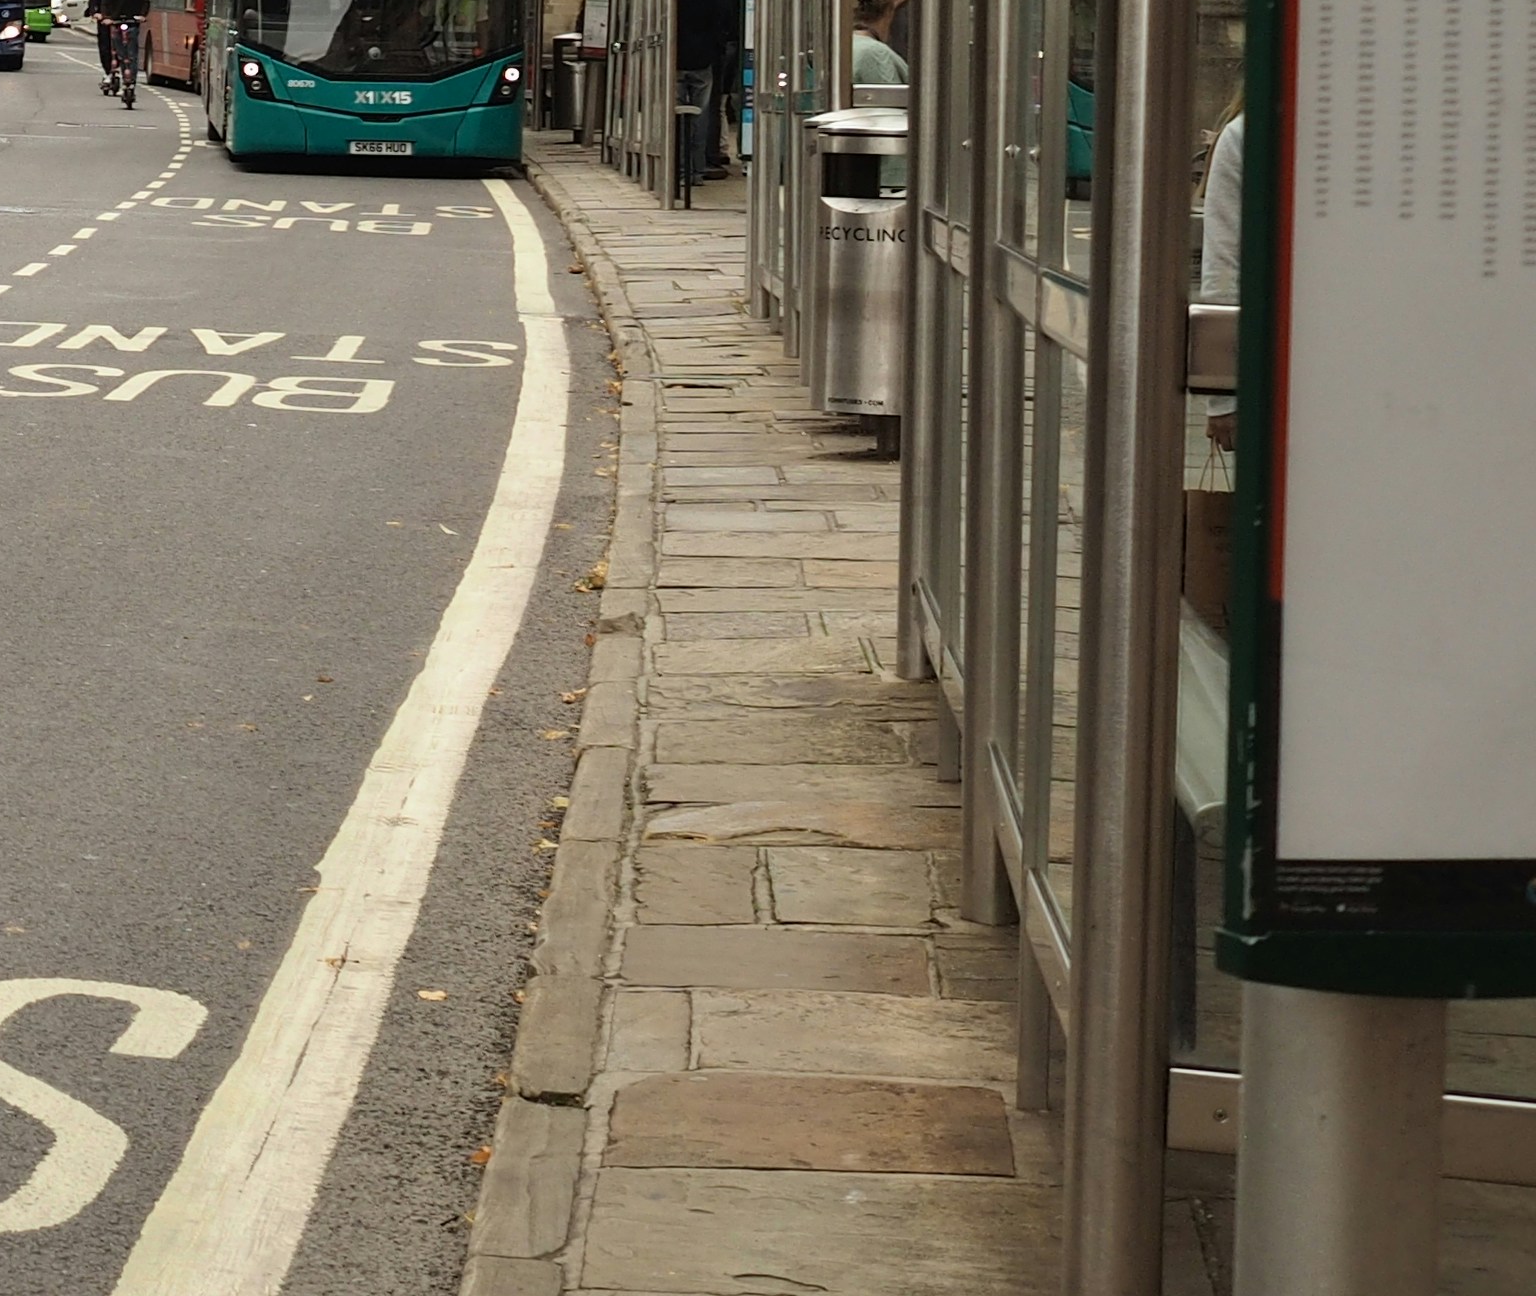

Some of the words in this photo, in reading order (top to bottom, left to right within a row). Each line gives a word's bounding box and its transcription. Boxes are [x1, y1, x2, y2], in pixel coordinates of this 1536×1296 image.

[354, 90, 375, 104] X1
[381, 91, 413, 104] X15
[355, 142, 383, 152] SK66
[150, 197, 495, 220] STAND
[192, 214, 433, 236] BUS
